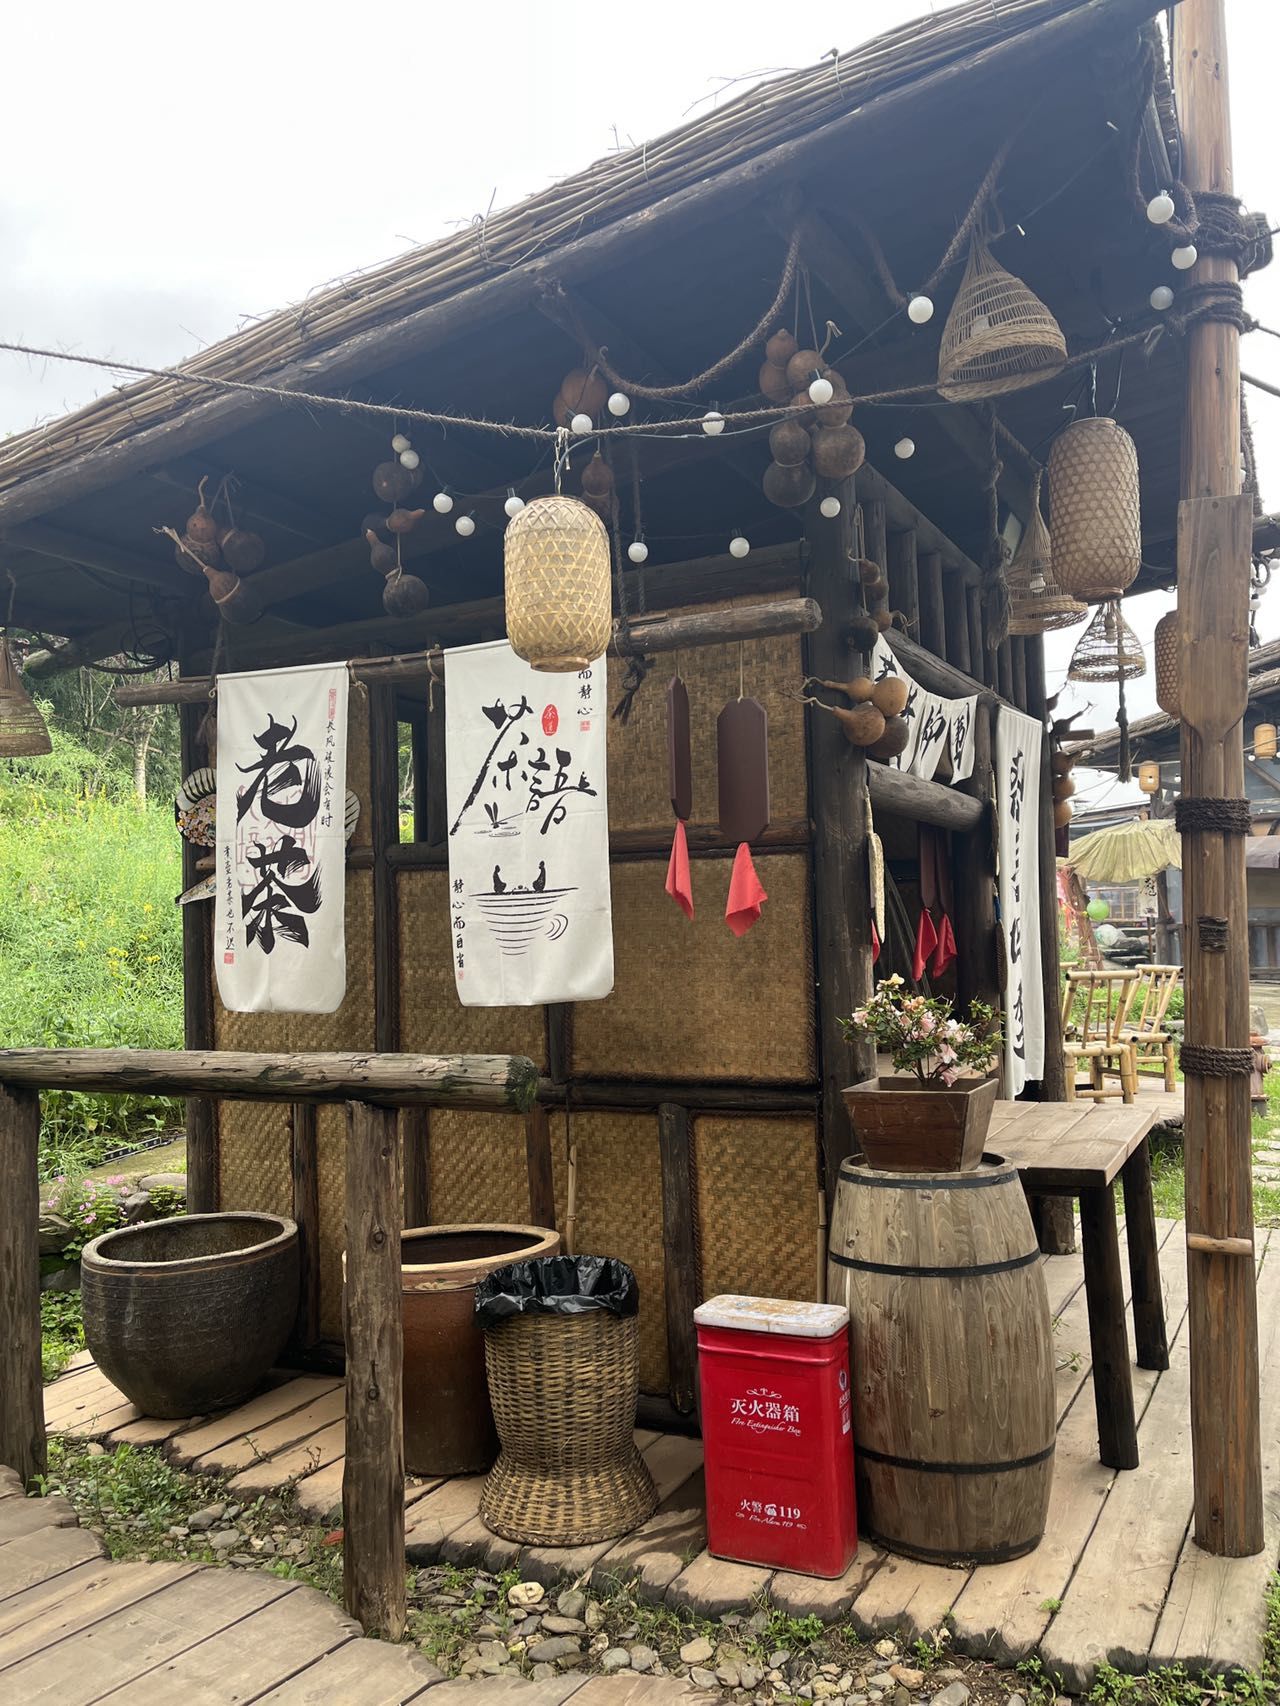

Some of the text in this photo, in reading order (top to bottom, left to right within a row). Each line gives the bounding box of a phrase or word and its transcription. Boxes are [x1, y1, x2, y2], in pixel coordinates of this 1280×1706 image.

[235, 713, 323, 955] 老茶
[730, 1398, 800, 1423] 灭火器箱
[740, 1499, 801, 1520] 火警 119
